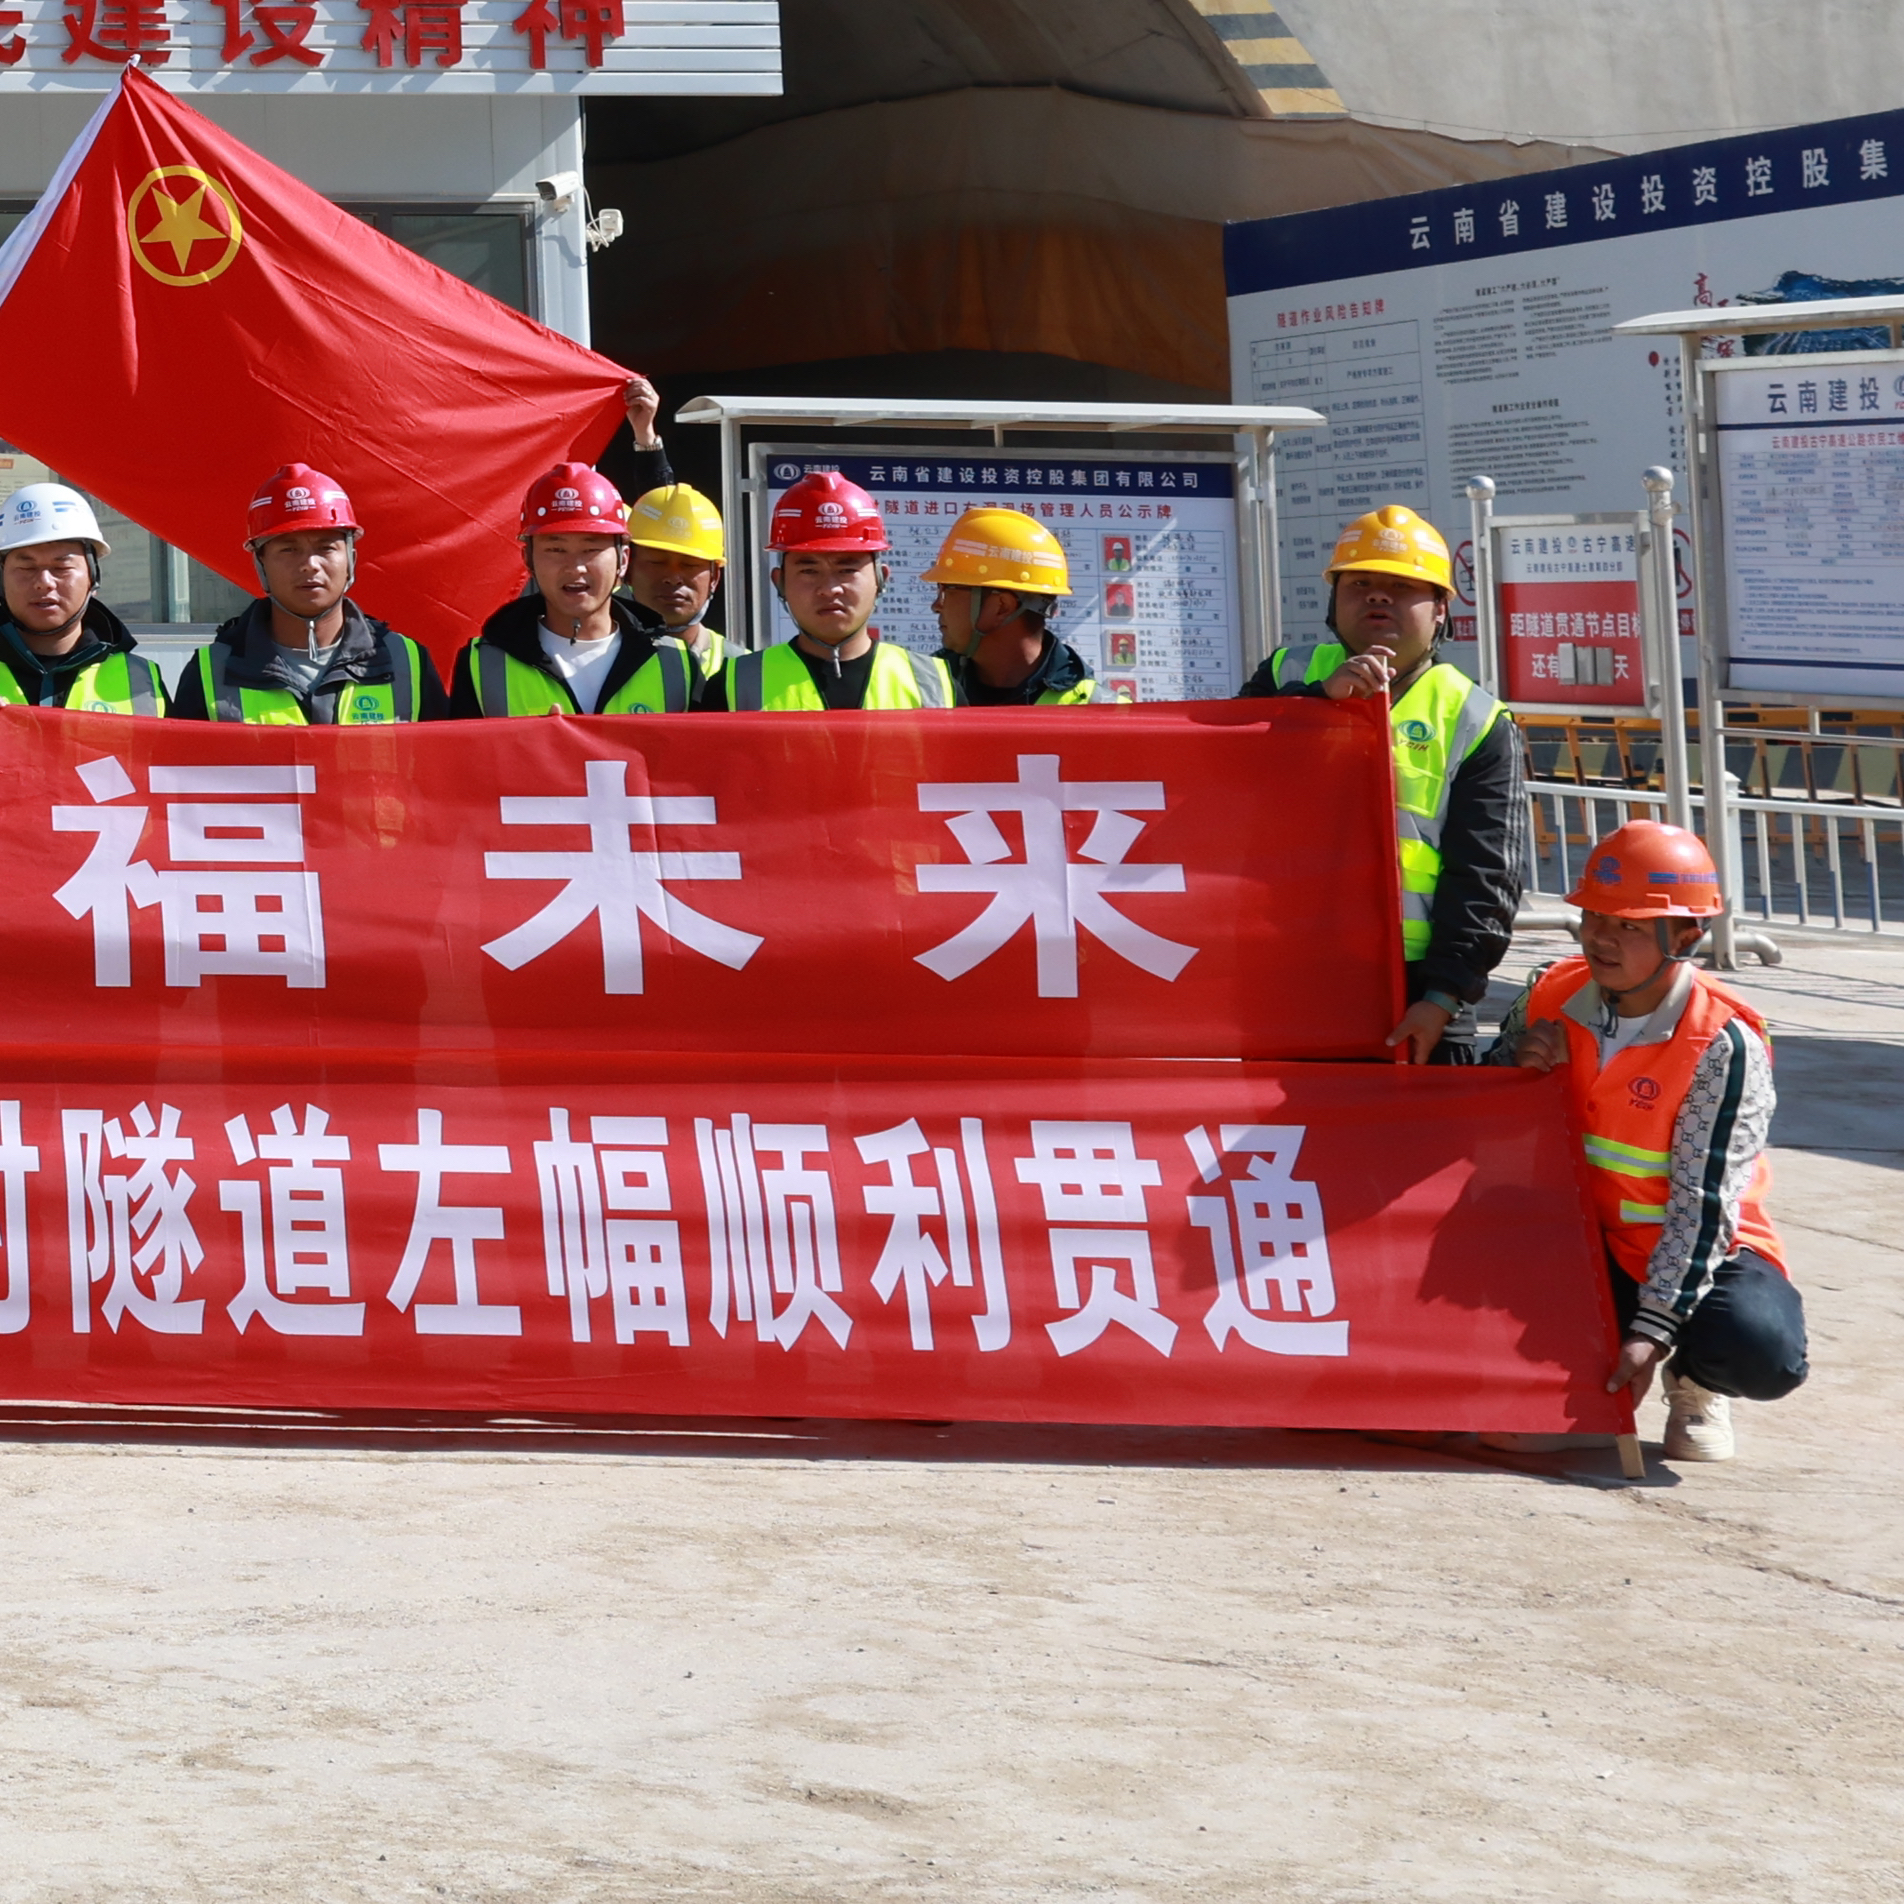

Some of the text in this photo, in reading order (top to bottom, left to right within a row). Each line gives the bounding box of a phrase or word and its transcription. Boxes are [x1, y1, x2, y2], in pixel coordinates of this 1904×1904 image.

[1409, 138, 1889, 251] 云南省建设投资控股集
[1277, 298, 1385, 328] 隧道作业风险告知牌
[1768, 377, 1880, 415] 云南建投
[870, 465, 1199, 489] 云南省建设投资控股集团有限公司
[285, 499, 316, 507] 云南建投
[14, 511, 41, 521] 云南建投
[815, 516, 848, 524] 云南建投
[1511, 535, 1635, 555] 云南建投 古宁高速
[988, 548, 1033, 564] 云南建投
[1532, 653, 1630, 679] 还有 天
[352, 713, 384, 721] 云南建投
[1398, 738, 1429, 752] YCIH
[1629, 1098, 1655, 1110] YCIH
